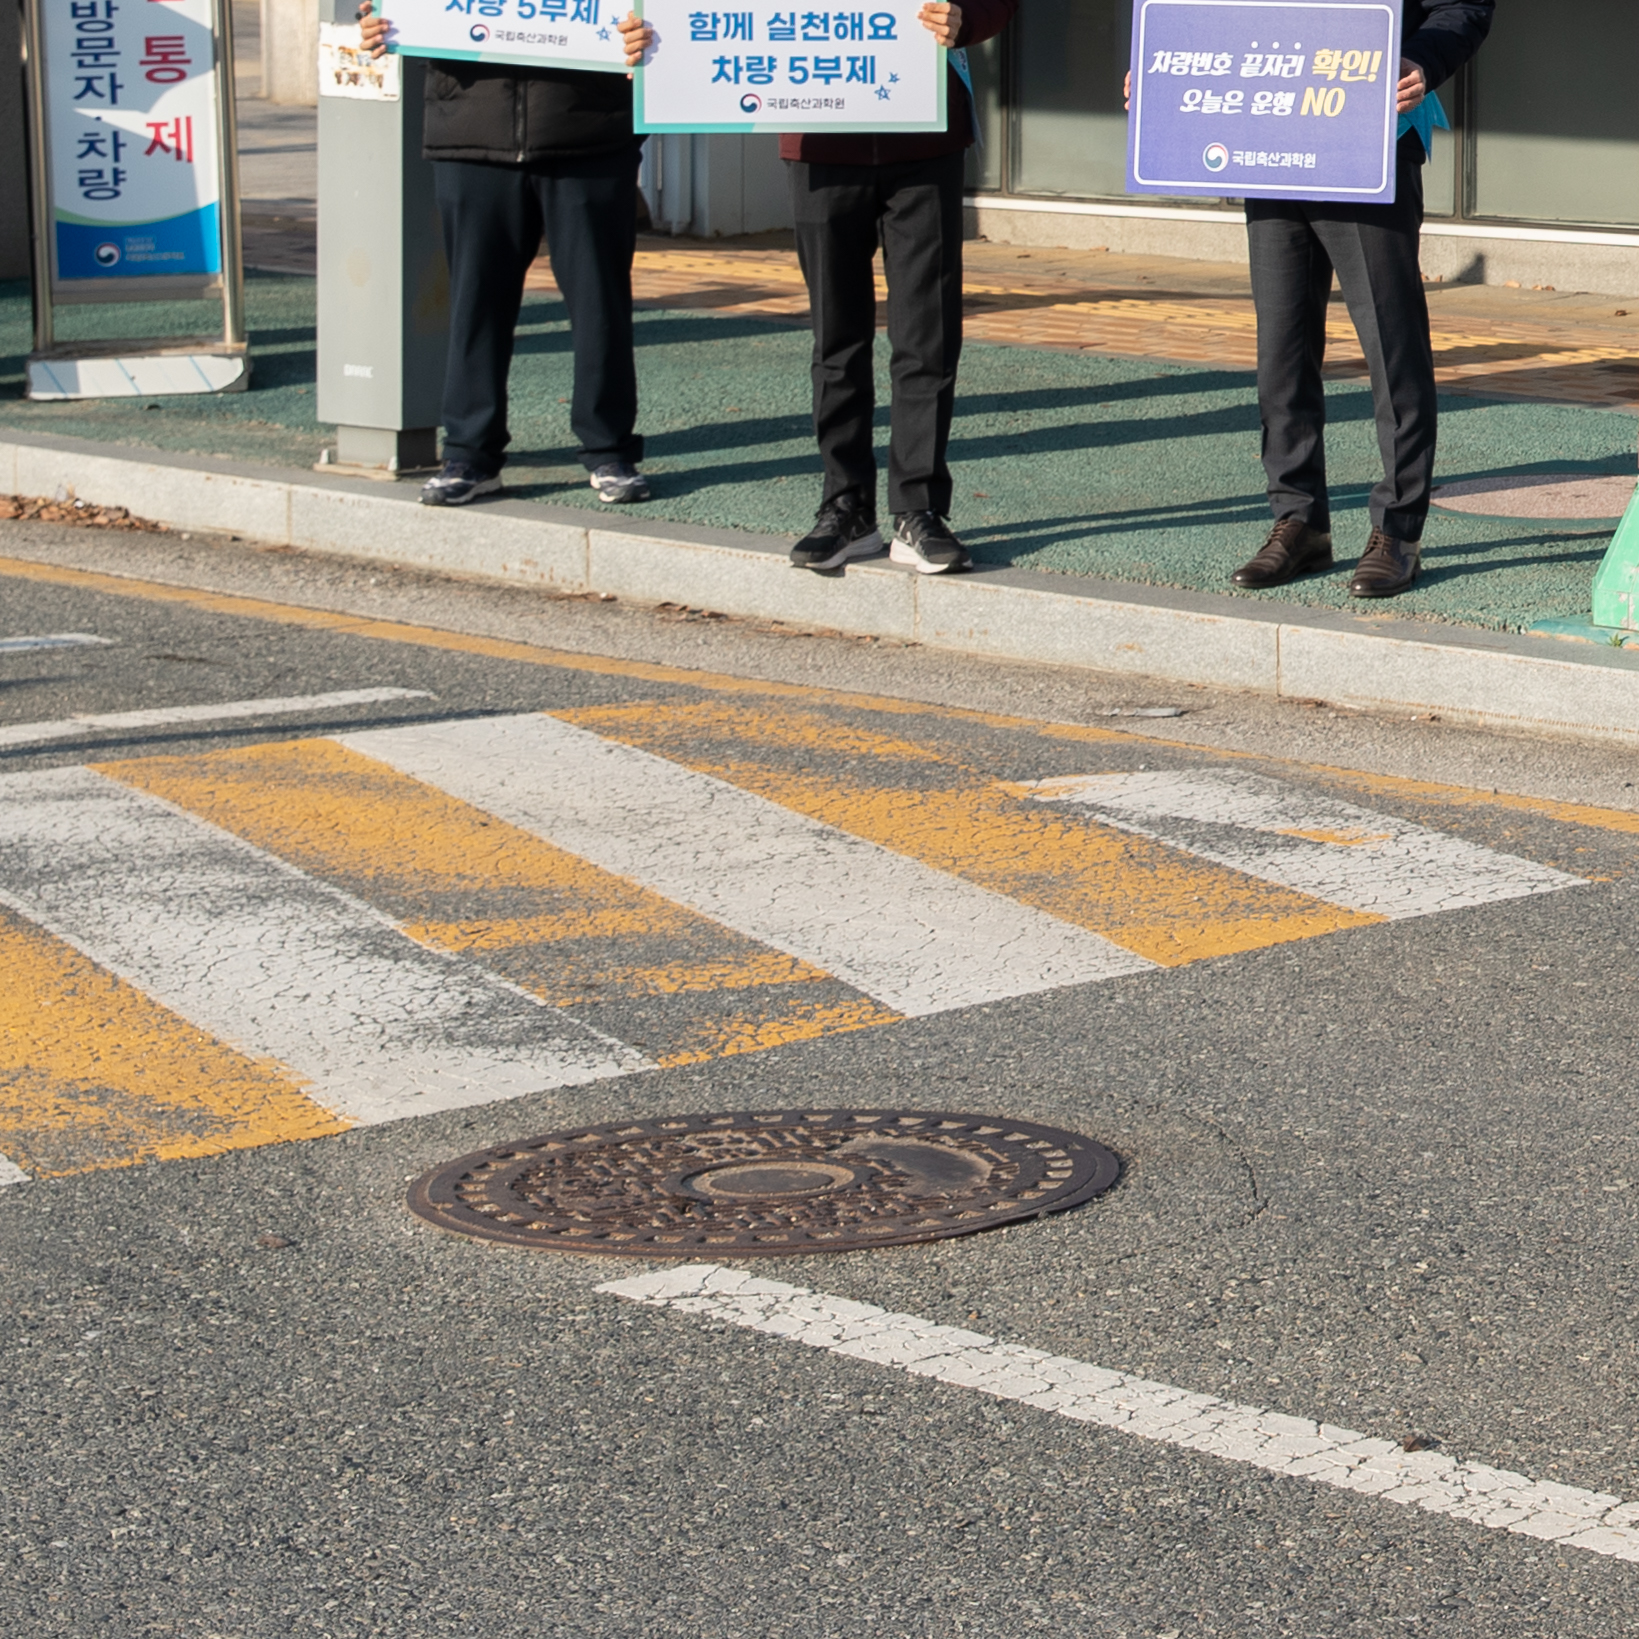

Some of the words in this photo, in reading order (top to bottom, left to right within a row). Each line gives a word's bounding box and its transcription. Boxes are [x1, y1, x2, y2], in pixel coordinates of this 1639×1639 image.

[494, 29, 568, 47] 국립축산과학원
[688, 11, 753, 42] 함께
[767, 11, 898, 42] 실천해요
[711, 56, 777, 86] 차량
[788, 56, 876, 86] 5부제
[1148, 50, 1234, 76] 차량번호
[1239, 52, 1305, 78] 끝자리
[1311, 49, 1383, 82] 확인!
[766, 97, 846, 110] 국립축산과학원
[1179, 89, 1244, 114] 오늘은
[1250, 91, 1296, 117] 운행
[1300, 87, 1346, 117] NO
[1232, 150, 1317, 169] 국립축산과학원
